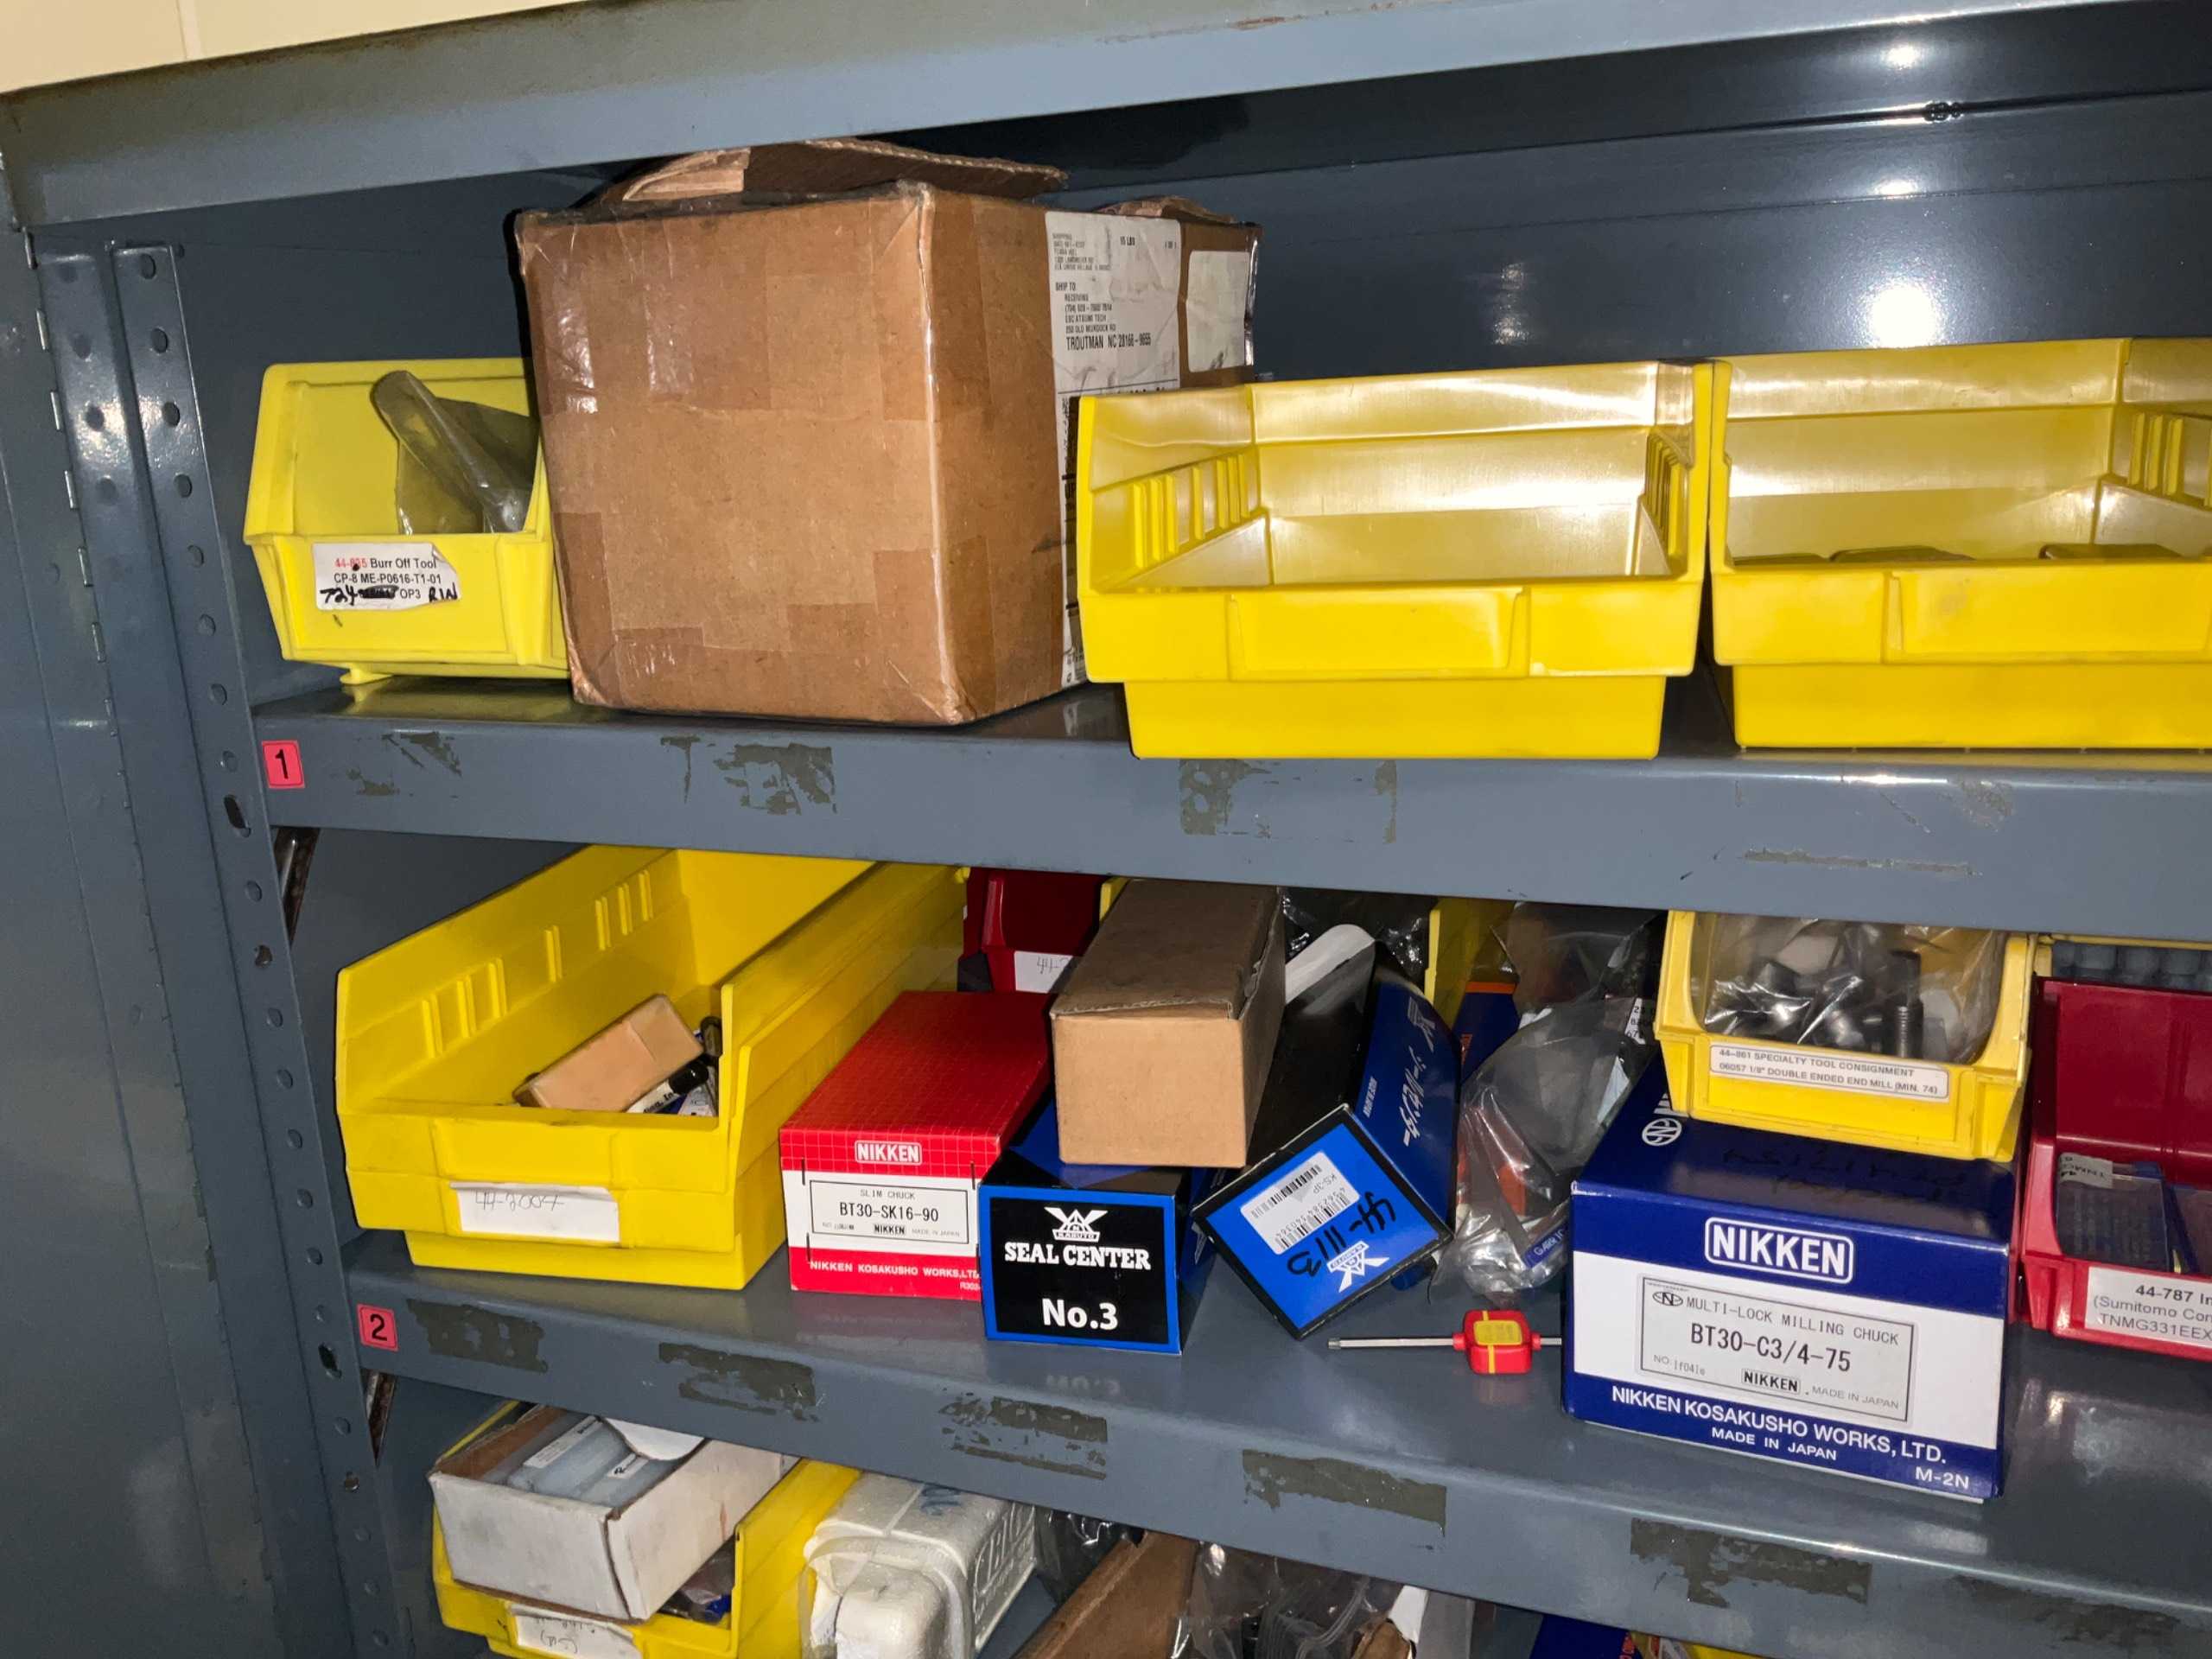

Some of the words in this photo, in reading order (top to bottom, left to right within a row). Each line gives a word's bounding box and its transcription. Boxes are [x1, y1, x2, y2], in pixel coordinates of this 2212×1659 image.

[1055, 282, 1068, 291] SHIP
[1069, 282, 1077, 291] TO
[1066, 335, 1103, 350] TROUTMAN
[1108, 334, 1116, 348] NC
[370, 557, 391, 569] Burr
[396, 557, 410, 569] Off
[415, 557, 436, 569] Tool
[334, 573, 358, 584] CP-8
[360, 574, 442, 585] ME-P0616-T1-01
[400, 588, 421, 599] OP3
[275, 748, 289, 779] 1
[1754, 1052, 1807, 1066] SPECIALTY
[1810, 1058, 1836, 1070] TOOL
[1839, 1062, 1914, 1078] CONSIGNMENT
[1767, 1067, 1808, 1080] DOUBLE
[1810, 1072, 1845, 1084] ENDED
[1847, 1077, 1867, 1087] END
[1870, 1078, 1892, 1090] MILL
[1923, 1084, 1938, 1096] 74)
[857, 1143, 919, 1163] NIKKEN
[860, 1189, 883, 1199] SLIM
[887, 1190, 916, 1200] CHUCK
[839, 1201, 939, 1223] BT30-SK16-90
[874, 1224, 906, 1236] NIKKEN
[1004, 1242, 1060, 1265] SEAL
[1063, 1244, 1152, 1271] CENTER
[1712, 1223, 1846, 1278] NIKKEN
[810, 1261, 854, 1273] NIKKEN
[858, 1263, 918, 1276] KOSAKUSHO
[2135, 1284, 2194, 1302] 44-787
[1042, 1297, 1119, 1331] No.3
[2094, 1294, 2177, 1319] (Sumitomo
[370, 1313, 388, 1341] 2
[1686, 1296, 1773, 1324] MULTI-LOCK
[1782, 1313, 1845, 1337] MILLING
[1853, 1325, 1899, 1346] CHUCK
[1690, 1322, 1852, 1374] BT30-C3/4-75
[1744, 1370, 1798, 1393] NIKKEN
[1812, 1385, 1847, 1399] MADE
[1848, 1389, 1859, 1401] IN
[1861, 1393, 1899, 1409] JAPAN
[1612, 1385, 1681, 1414] NIKKEN
[1685, 1400, 1808, 1438] KOSAKUSHO
[1813, 1424, 1897, 1458] WORKS,
[1901, 1441, 1947, 1465] LTD.
[1711, 1427, 1756, 1446] MADE
[1764, 1437, 1779, 1450] IN
[1787, 1441, 1838, 1461] JAPAN
[1915, 1466, 1970, 1491] M-2N
